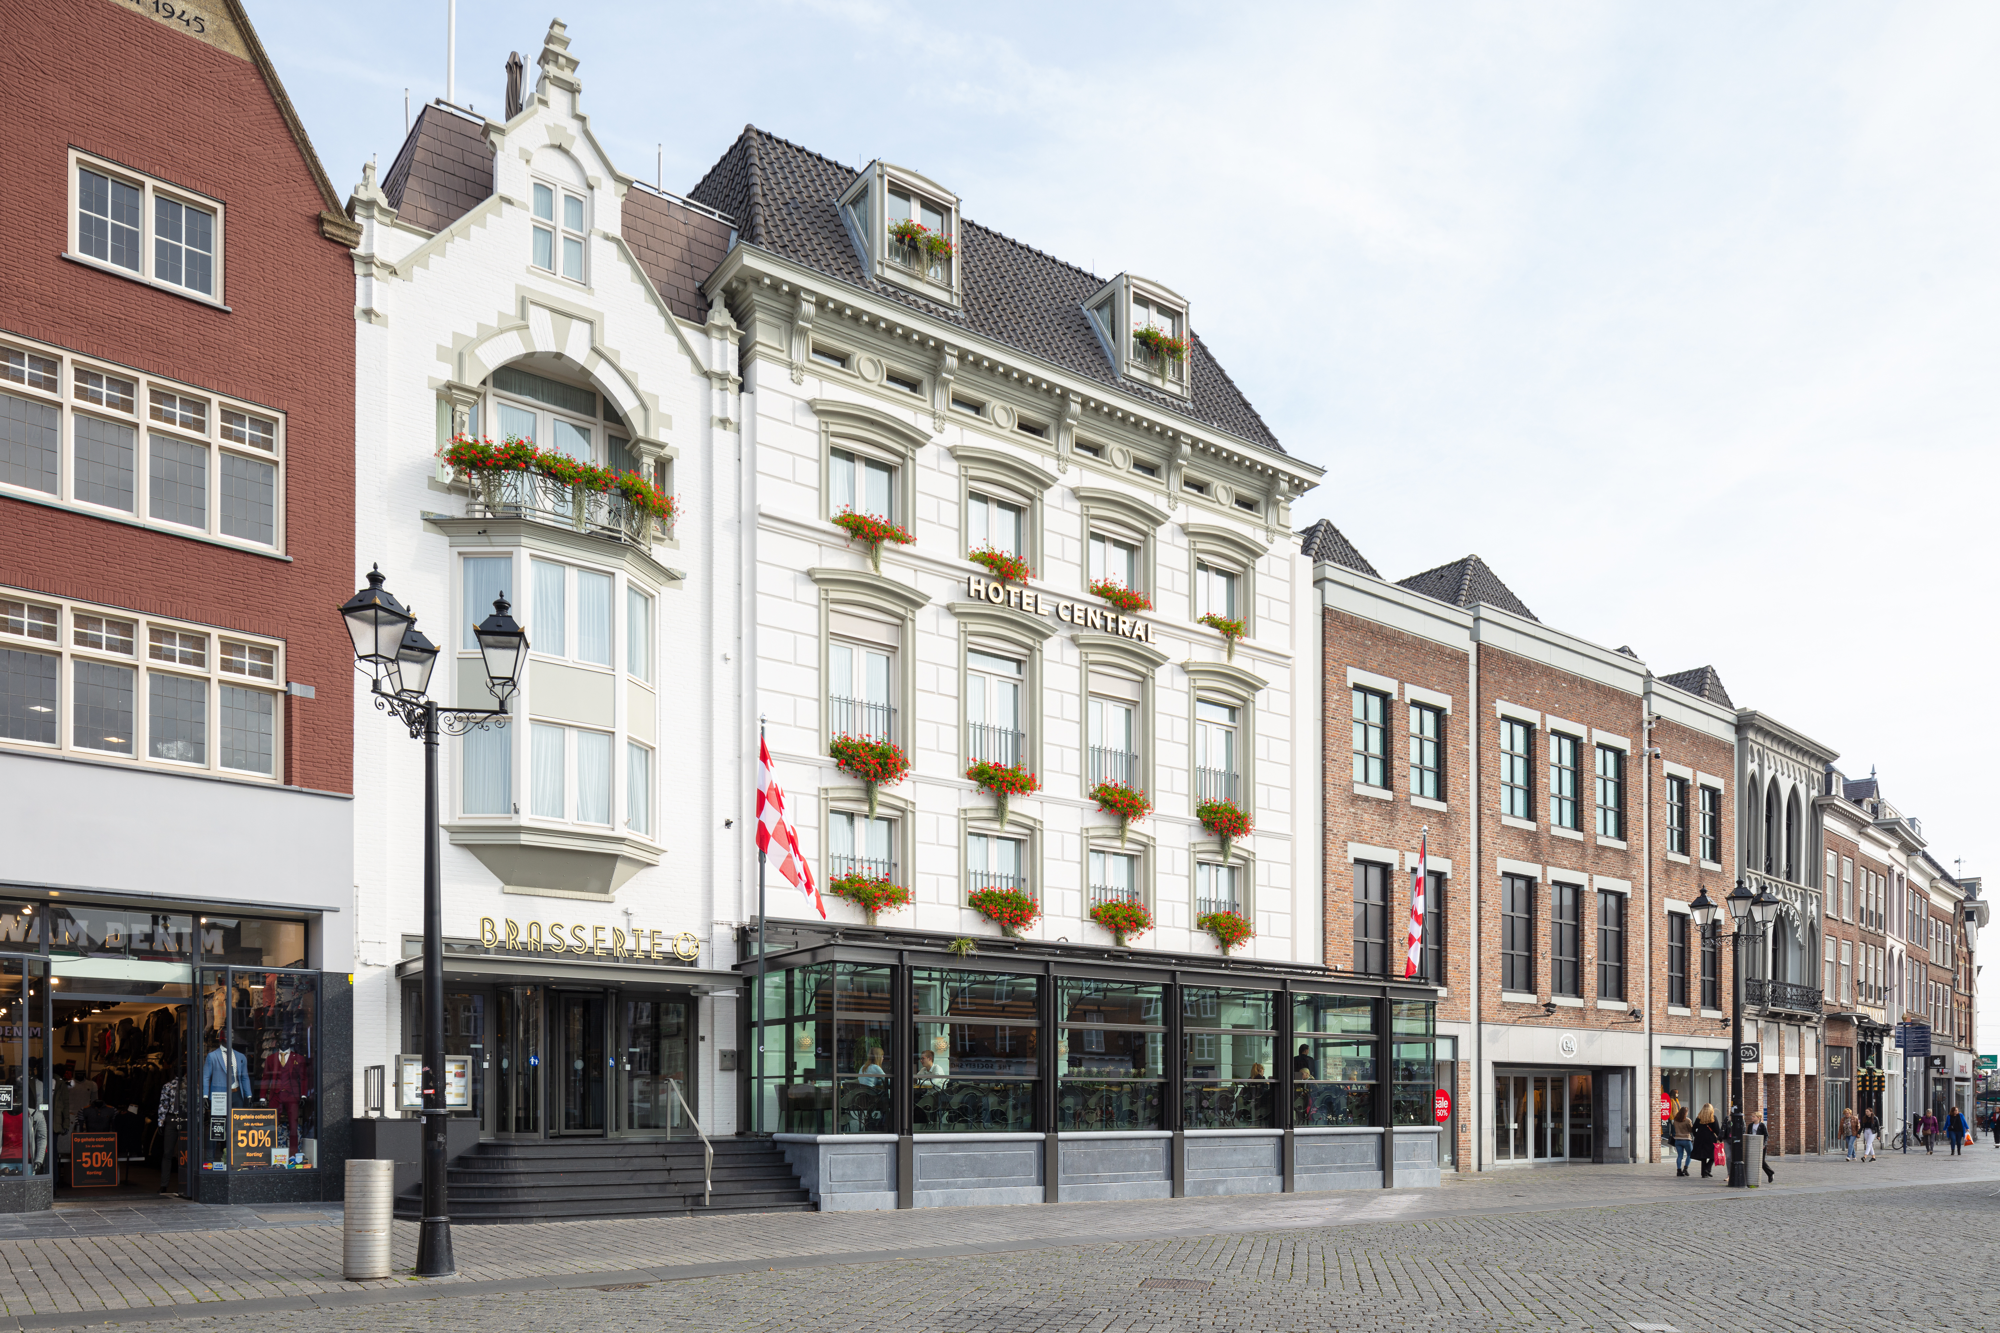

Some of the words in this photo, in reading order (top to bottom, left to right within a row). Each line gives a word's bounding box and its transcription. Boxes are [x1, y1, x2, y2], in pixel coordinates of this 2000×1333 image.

[153, 0, 205, 34] 1945
[967, 574, 1049, 617] HOTEL
[1056, 599, 1158, 645] CENTRAL
[105, 920, 225, 956] DENIM
[480, 915, 663, 961] BRASSERIE
[237, 1129, 271, 1148] 50%
[76, 1151, 113, 1168] -50%
